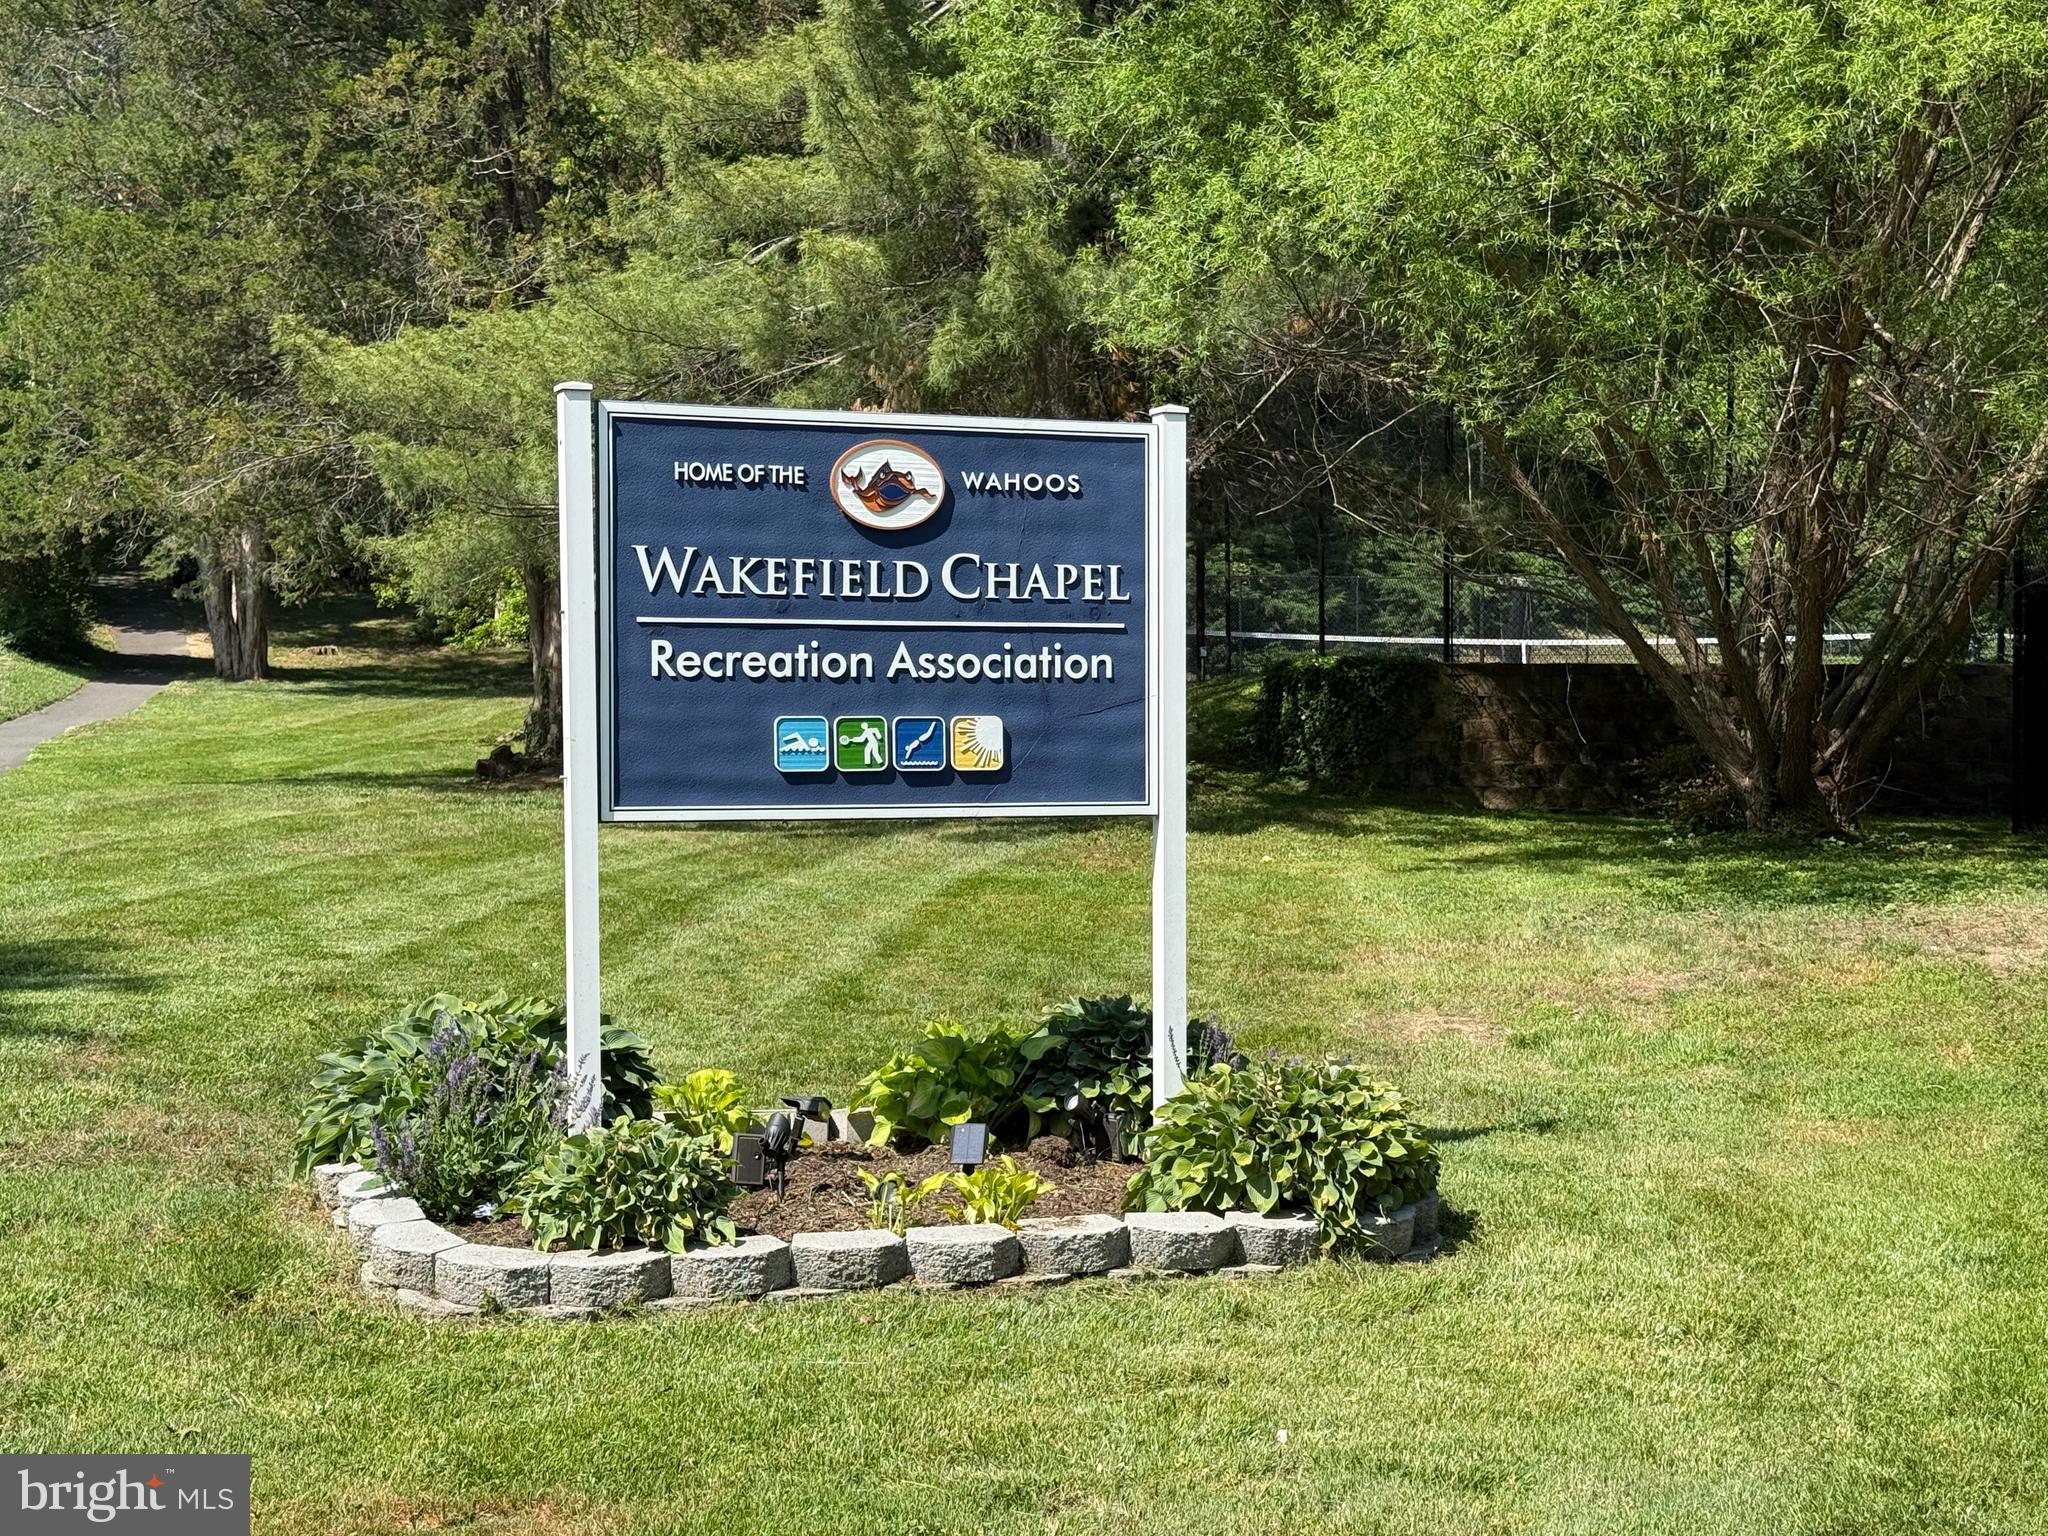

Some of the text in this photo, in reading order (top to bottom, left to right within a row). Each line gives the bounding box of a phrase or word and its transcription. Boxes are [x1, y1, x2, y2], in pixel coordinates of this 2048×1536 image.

[674, 461, 1081, 493] HOME OF THE WAHOOS
[631, 544, 1131, 602] WAKEFIELD CHAPEL
[650, 639, 1114, 680] Recreation Association
